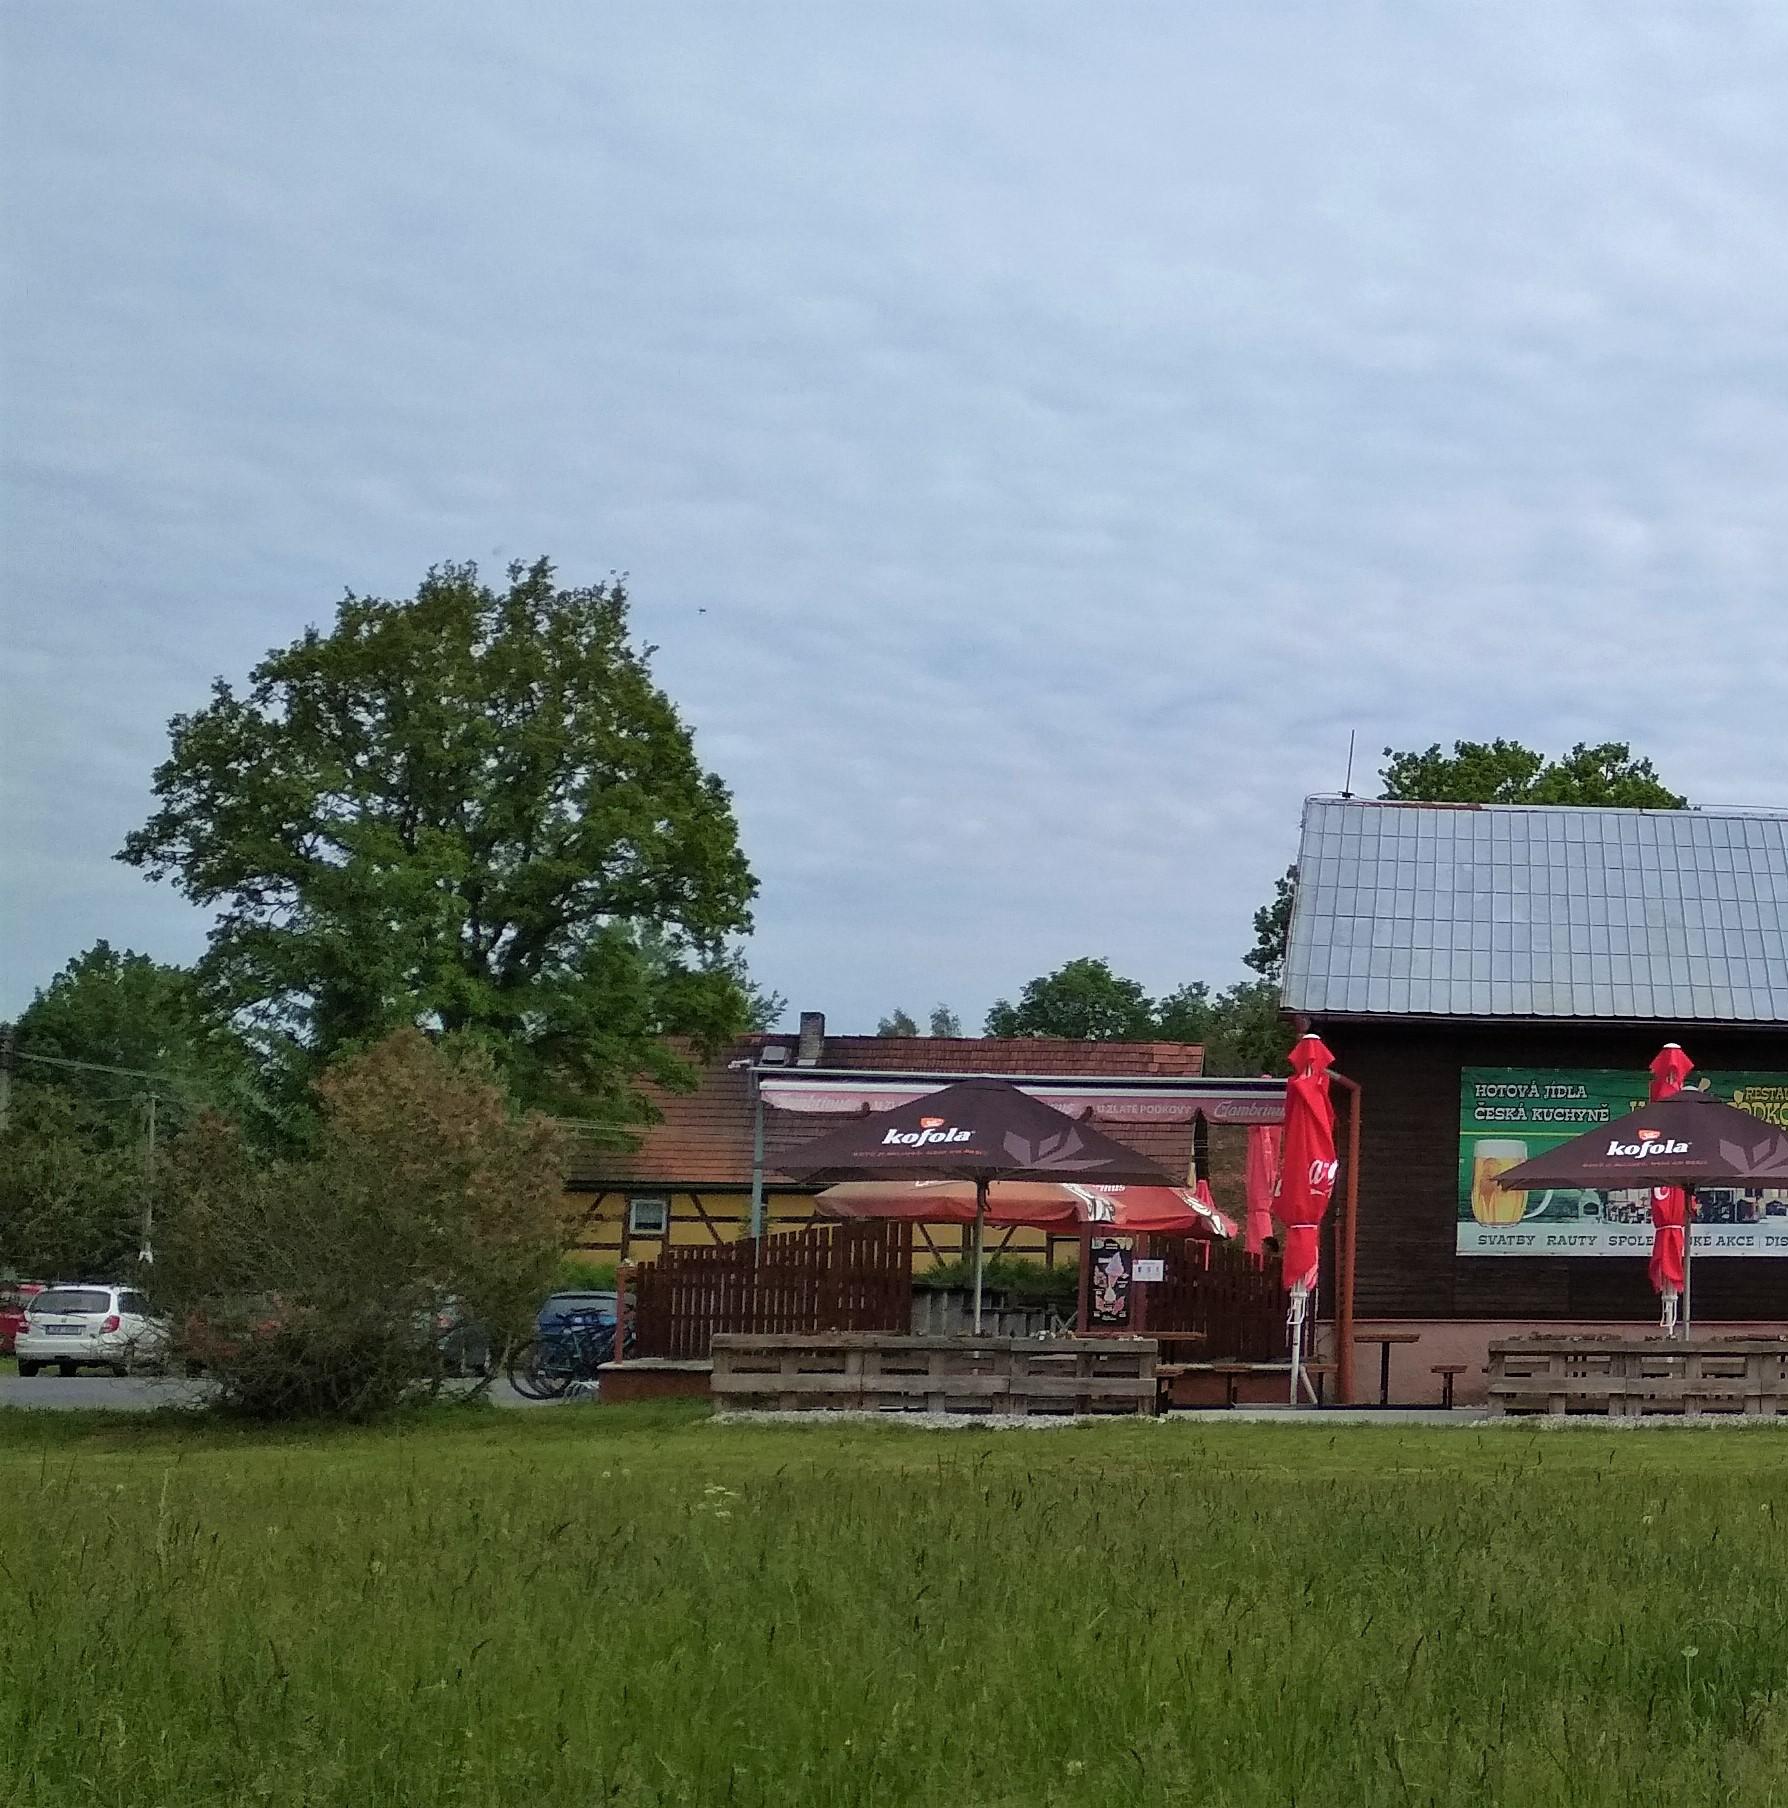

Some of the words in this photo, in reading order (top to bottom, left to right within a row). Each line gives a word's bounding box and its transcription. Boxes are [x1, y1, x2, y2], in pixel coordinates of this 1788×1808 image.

[1475, 1081, 1540, 1098] HOTOVÁ
[1543, 1082, 1588, 1099] JÍDLA
[1474, 1102, 1528, 1121] ČESKÁ
[1532, 1103, 1609, 1122] KUCHYNĚ
[881, 1127, 972, 1148] kofola
[1606, 1139, 1690, 1159] kofola
[1478, 1235, 1536, 1246] SVATBY
[1546, 1235, 1598, 1246] RAUTY
[1716, 1235, 1754, 1247] AKCE
